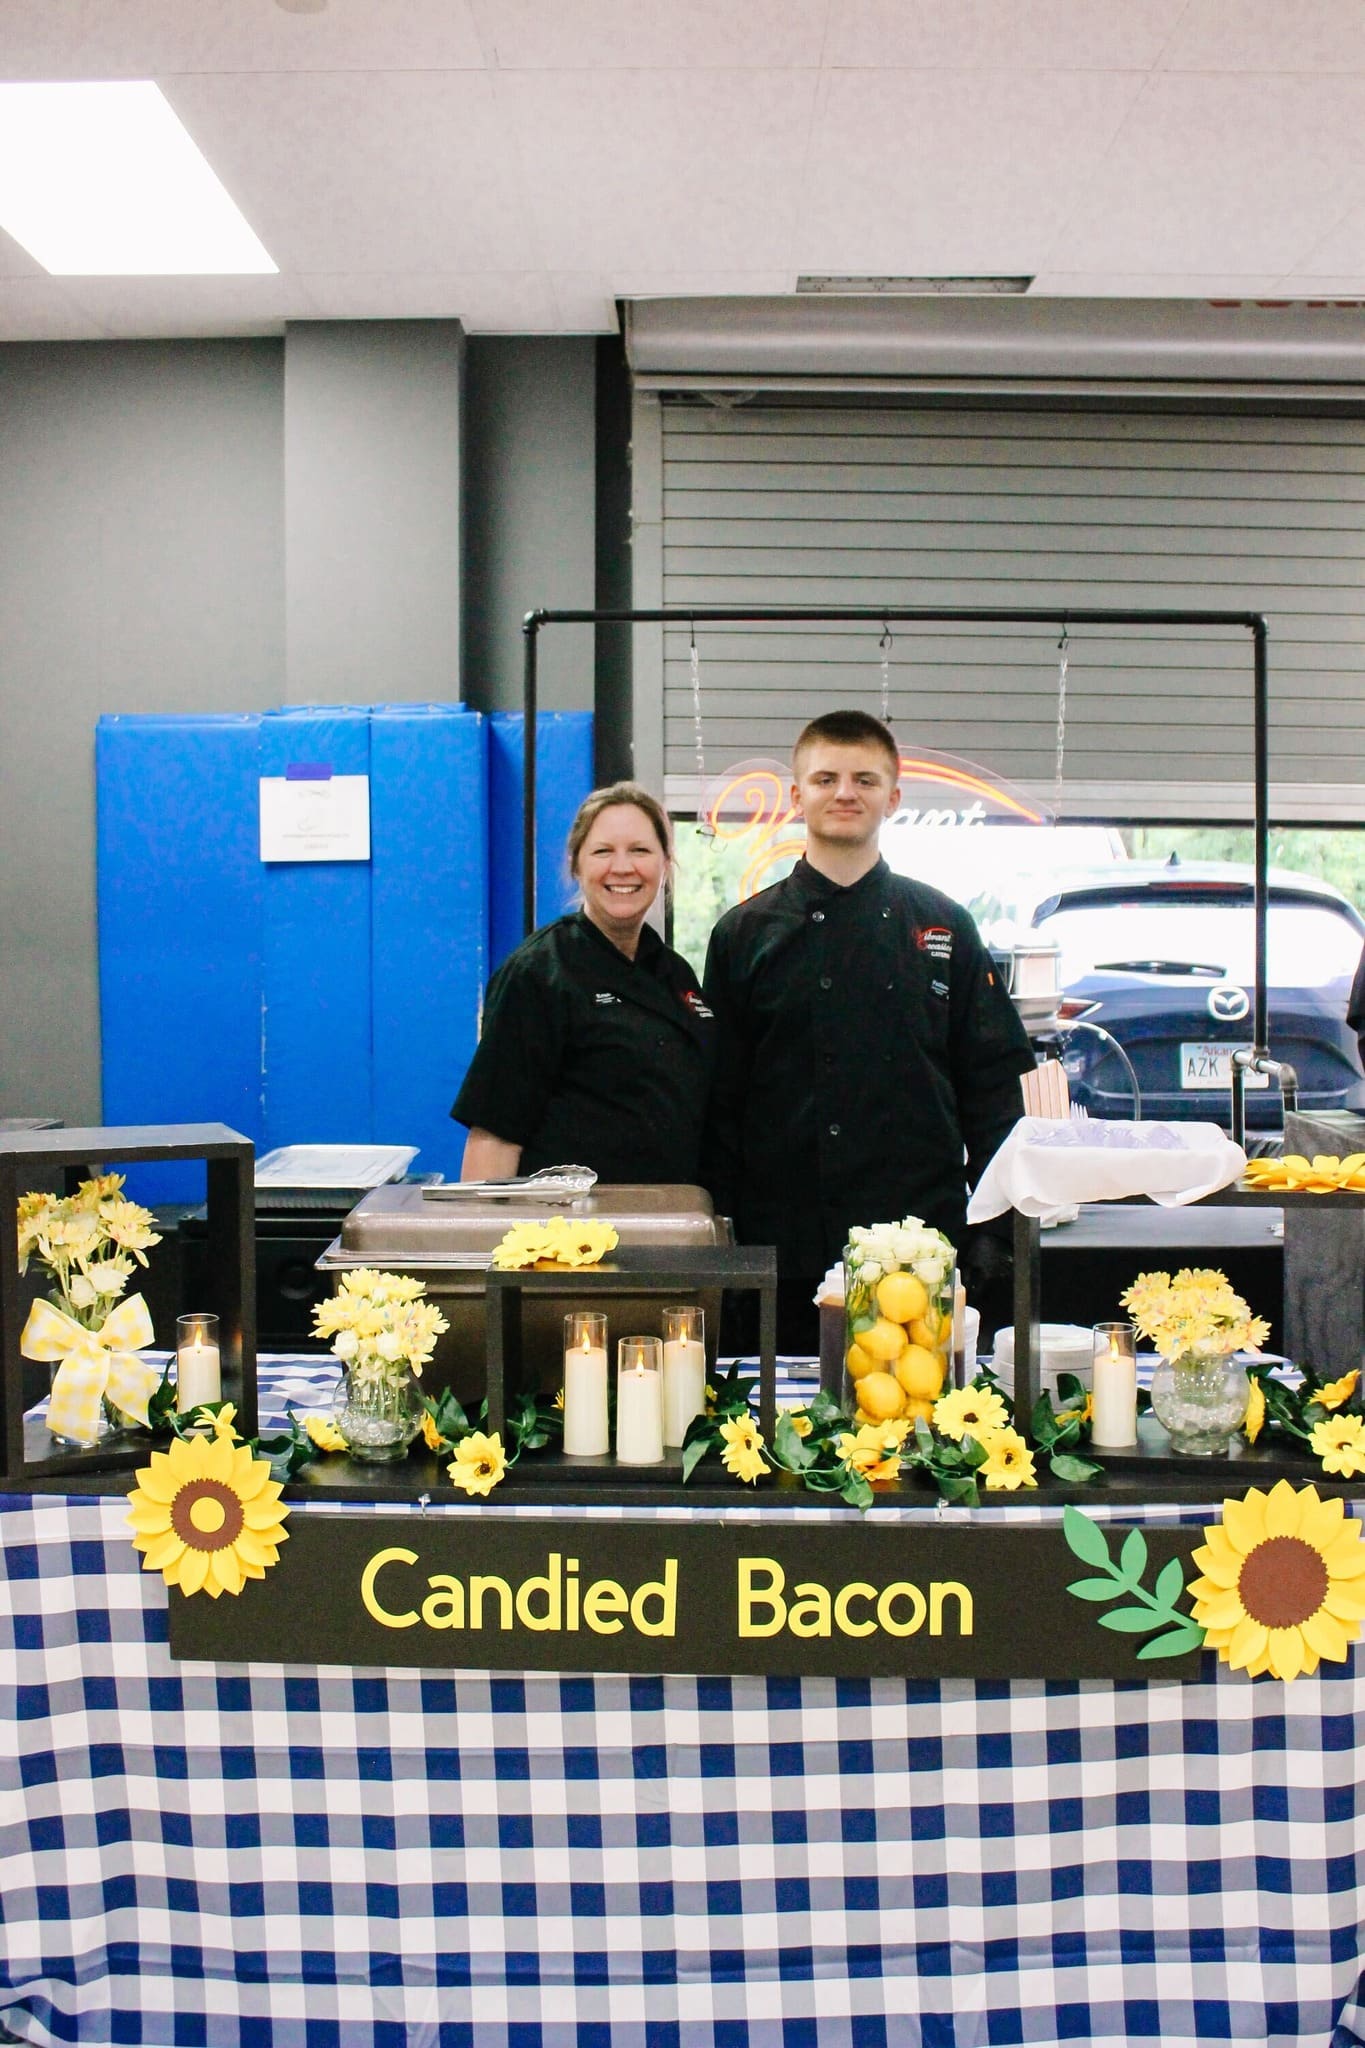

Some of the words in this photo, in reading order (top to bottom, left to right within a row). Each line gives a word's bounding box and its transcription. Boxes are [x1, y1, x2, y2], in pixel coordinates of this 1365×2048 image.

[1187, 1058, 1219, 1077] AZK
[361, 1548, 677, 1637] Candied
[738, 1558, 974, 1638] Bacon
